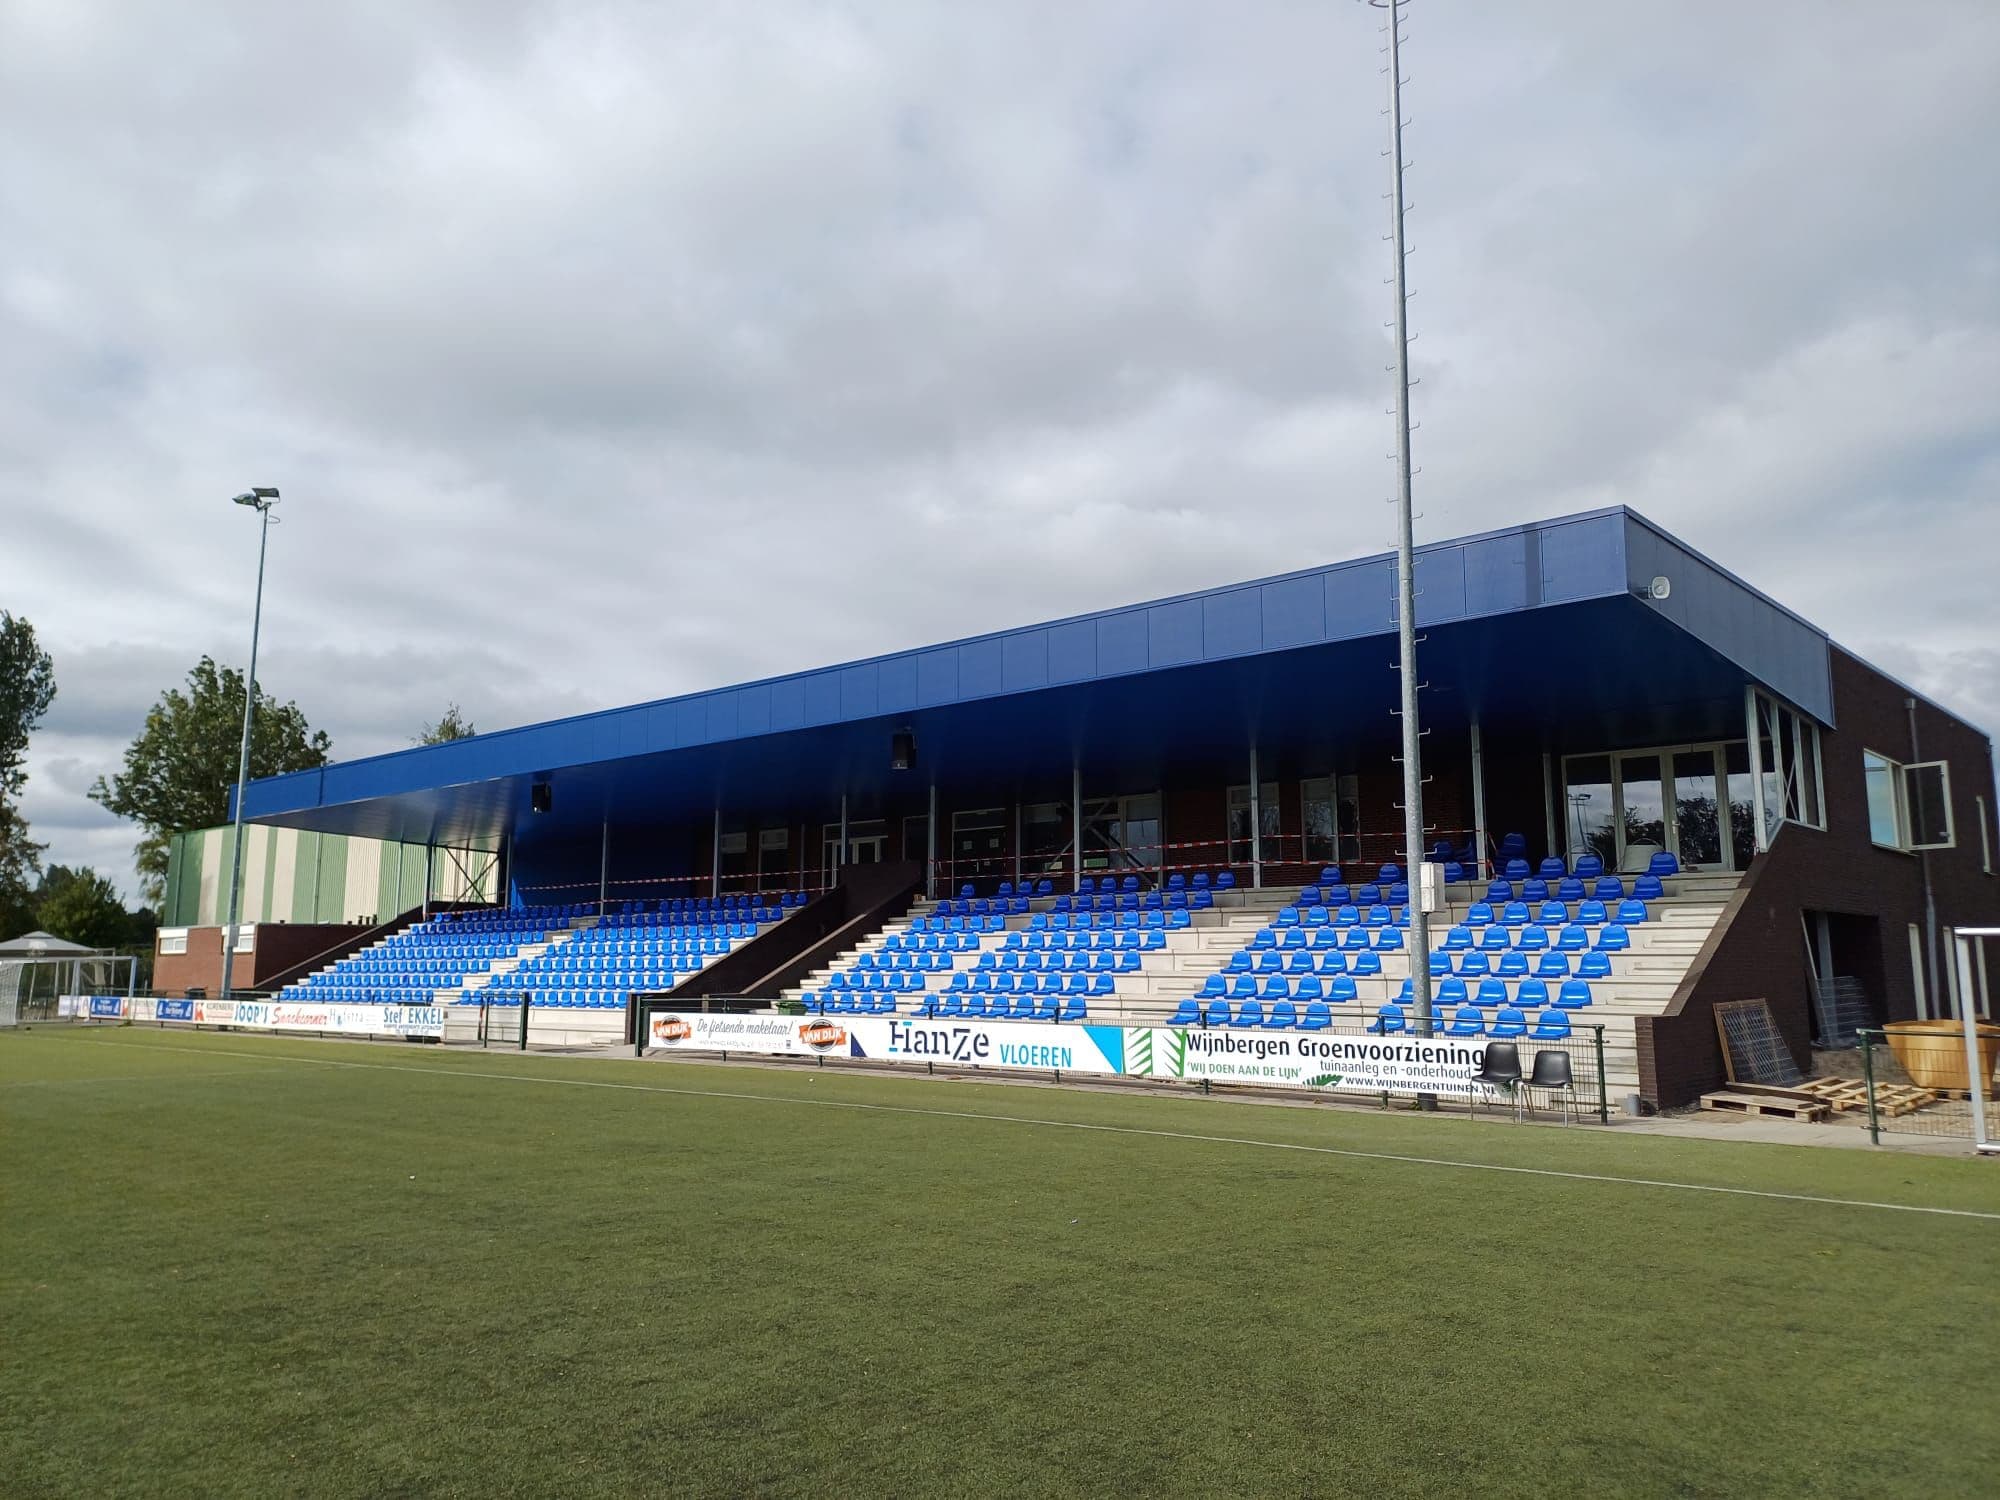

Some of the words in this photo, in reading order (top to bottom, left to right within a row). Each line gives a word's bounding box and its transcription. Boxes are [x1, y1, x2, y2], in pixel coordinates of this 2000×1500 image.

[383, 1007, 402, 1024] Stef
[408, 1008, 443, 1025] EKKEL
[655, 1025, 671, 1036] VAN
[671, 1023, 689, 1034] DIJK
[697, 1019, 708, 1032] De
[708, 1019, 744, 1038] fietsende
[745, 1019, 793, 1035] makelaar!
[802, 1029, 821, 1041] VAN
[822, 1028, 843, 1039] DIJK
[1000, 1043, 1072, 1068] VLOEREN
[1187, 1033, 1290, 1059] Wijnbergen
[1298, 1038, 1484, 1071] Groenvoorziening
[1209, 1063, 1235, 1074] DOEN
[1238, 1064, 1260, 1075] AAN
[1263, 1066, 1276, 1076] DE
[1320, 1060, 1379, 1076] tuinaanleg
[1383, 1065, 1397, 1075] en
[1400, 1063, 1471, 1080] -onderhoud
[1345, 1077, 1496, 1095] WWW.WIJNBERGENTUINEN.NL
